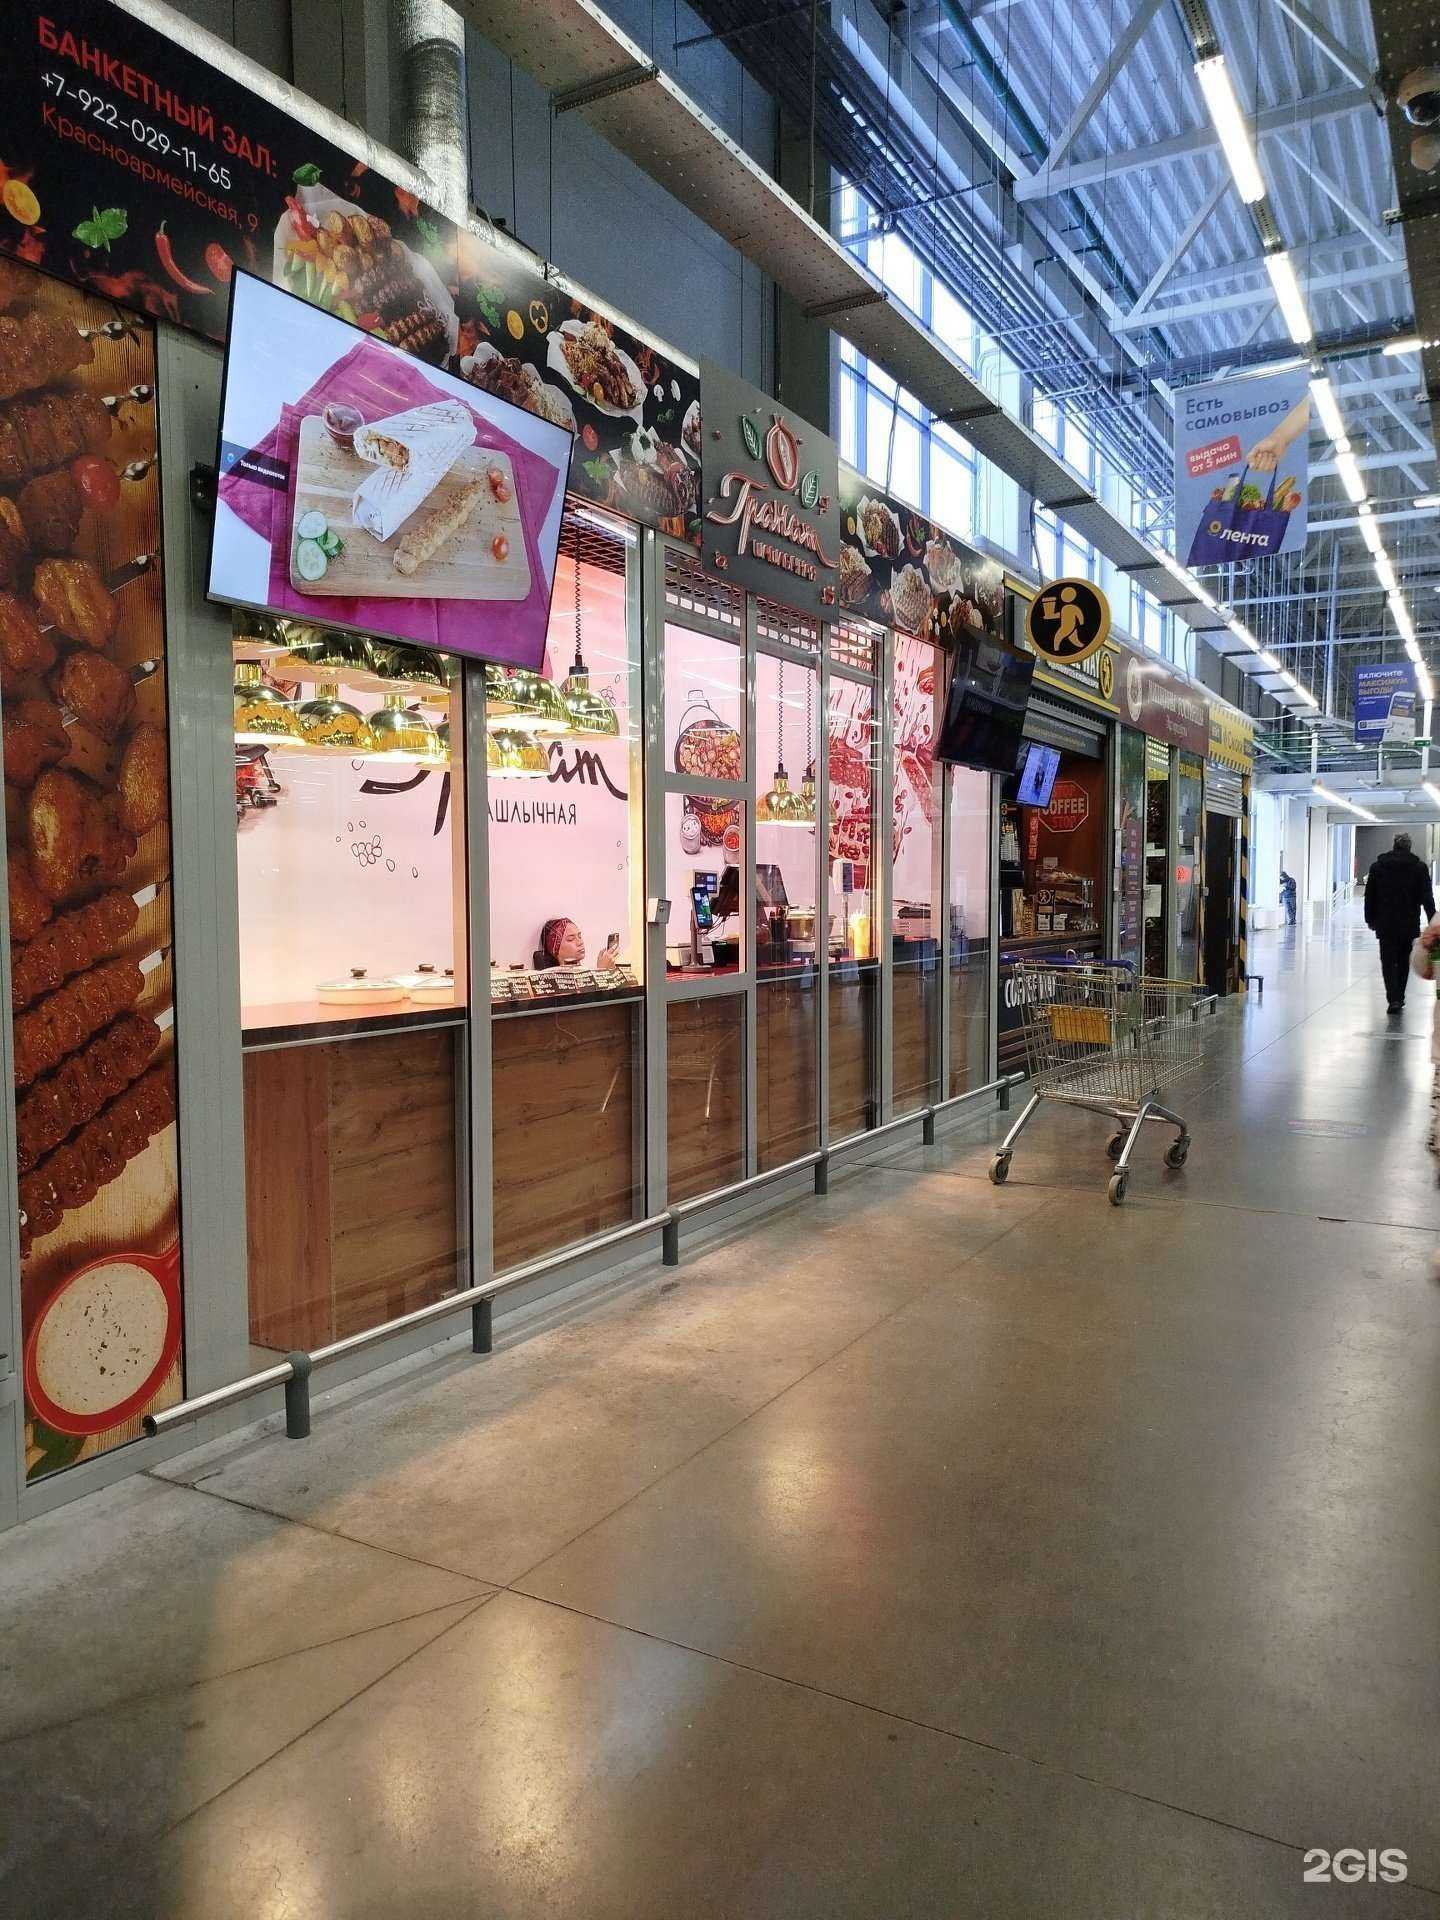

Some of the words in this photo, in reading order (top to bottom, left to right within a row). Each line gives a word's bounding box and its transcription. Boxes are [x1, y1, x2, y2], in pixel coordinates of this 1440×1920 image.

[37, 16, 216, 143] БАНКЕТНЫЙ
[222, 125, 278, 178] ЗАЛ:
[41, 72, 232, 190] +7-922-029-11-65
[41, 102, 243, 230] Красноармейская,
[247, 213, 260, 232] 9
[1185, 400, 1290, 431] самовывоз
[1186, 398, 1224, 415] Есть
[1191, 463, 1204, 473] от
[1206, 458, 1213, 468] 5
[1215, 451, 1237, 465] мин
[1220, 526, 1270, 547] лента
[488, 799, 577, 825] АШЛЫЧНАЯ
